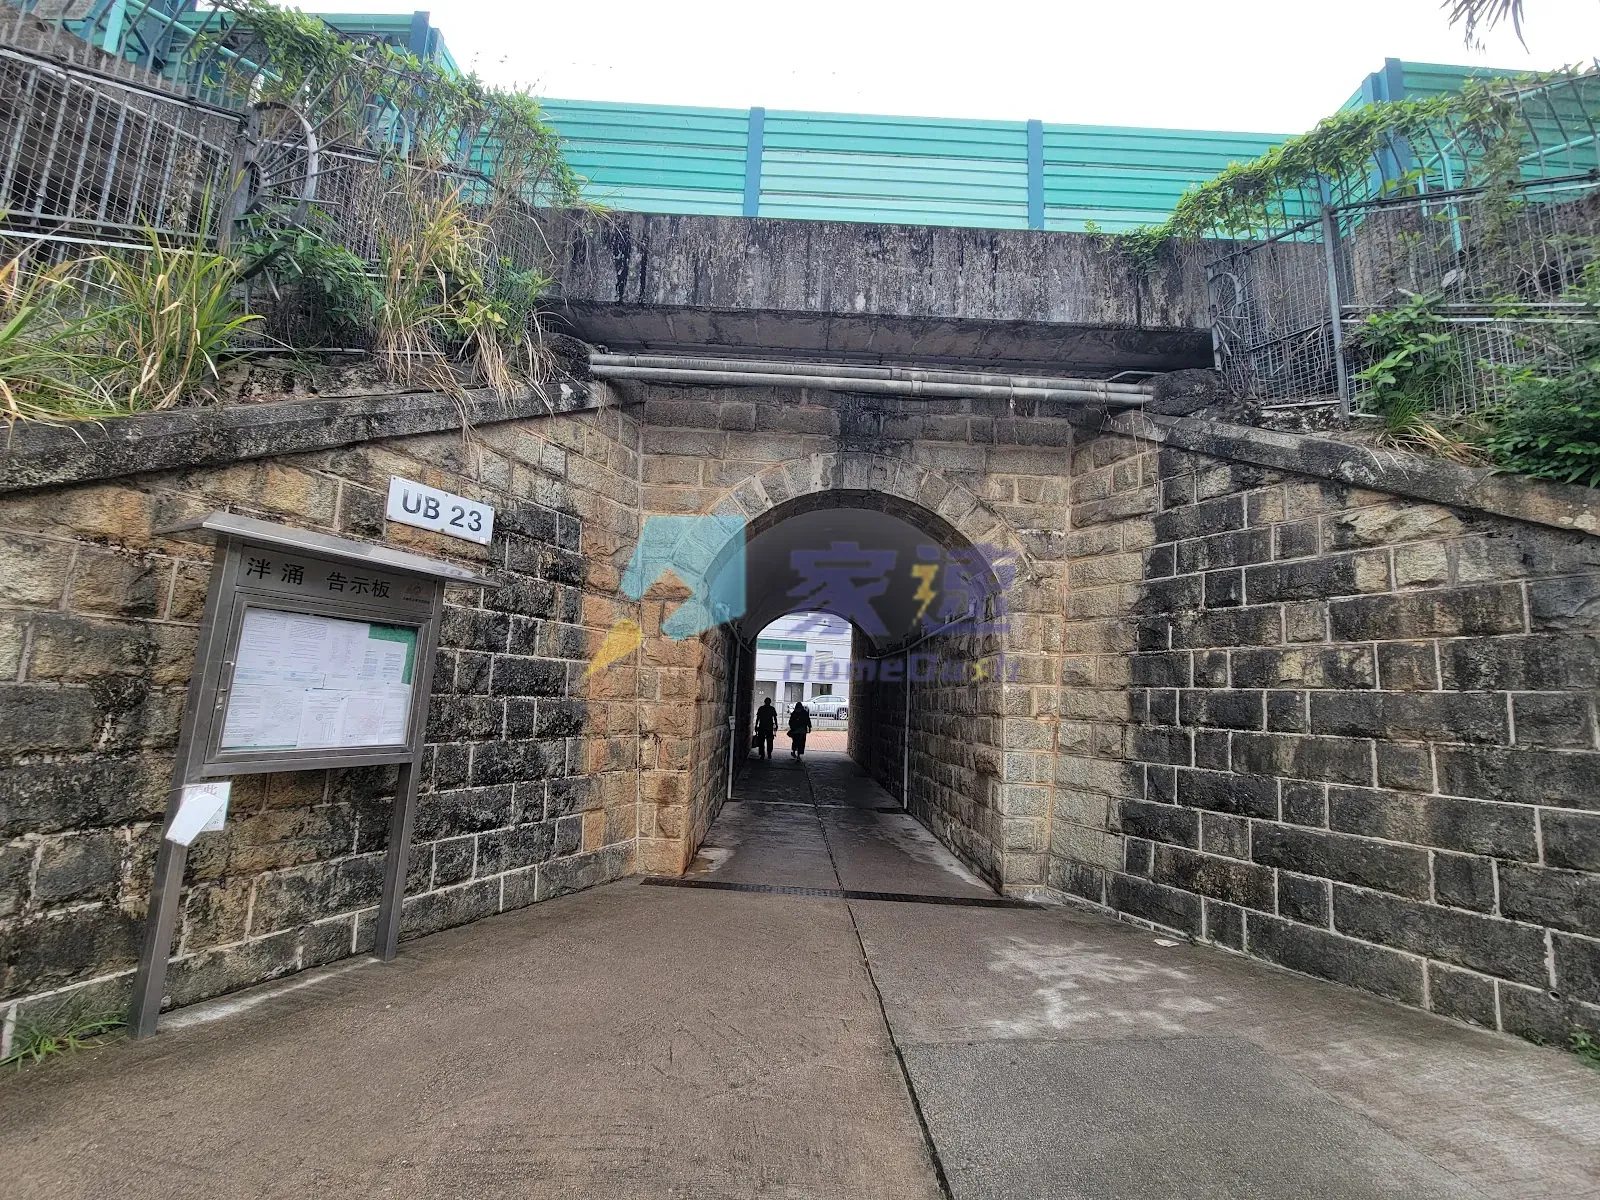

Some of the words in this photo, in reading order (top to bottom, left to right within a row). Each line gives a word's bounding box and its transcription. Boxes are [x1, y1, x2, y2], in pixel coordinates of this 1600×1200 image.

[402, 488, 440, 520] UB
[449, 504, 482, 532] 23
[326, 571, 391, 599] 告示板
